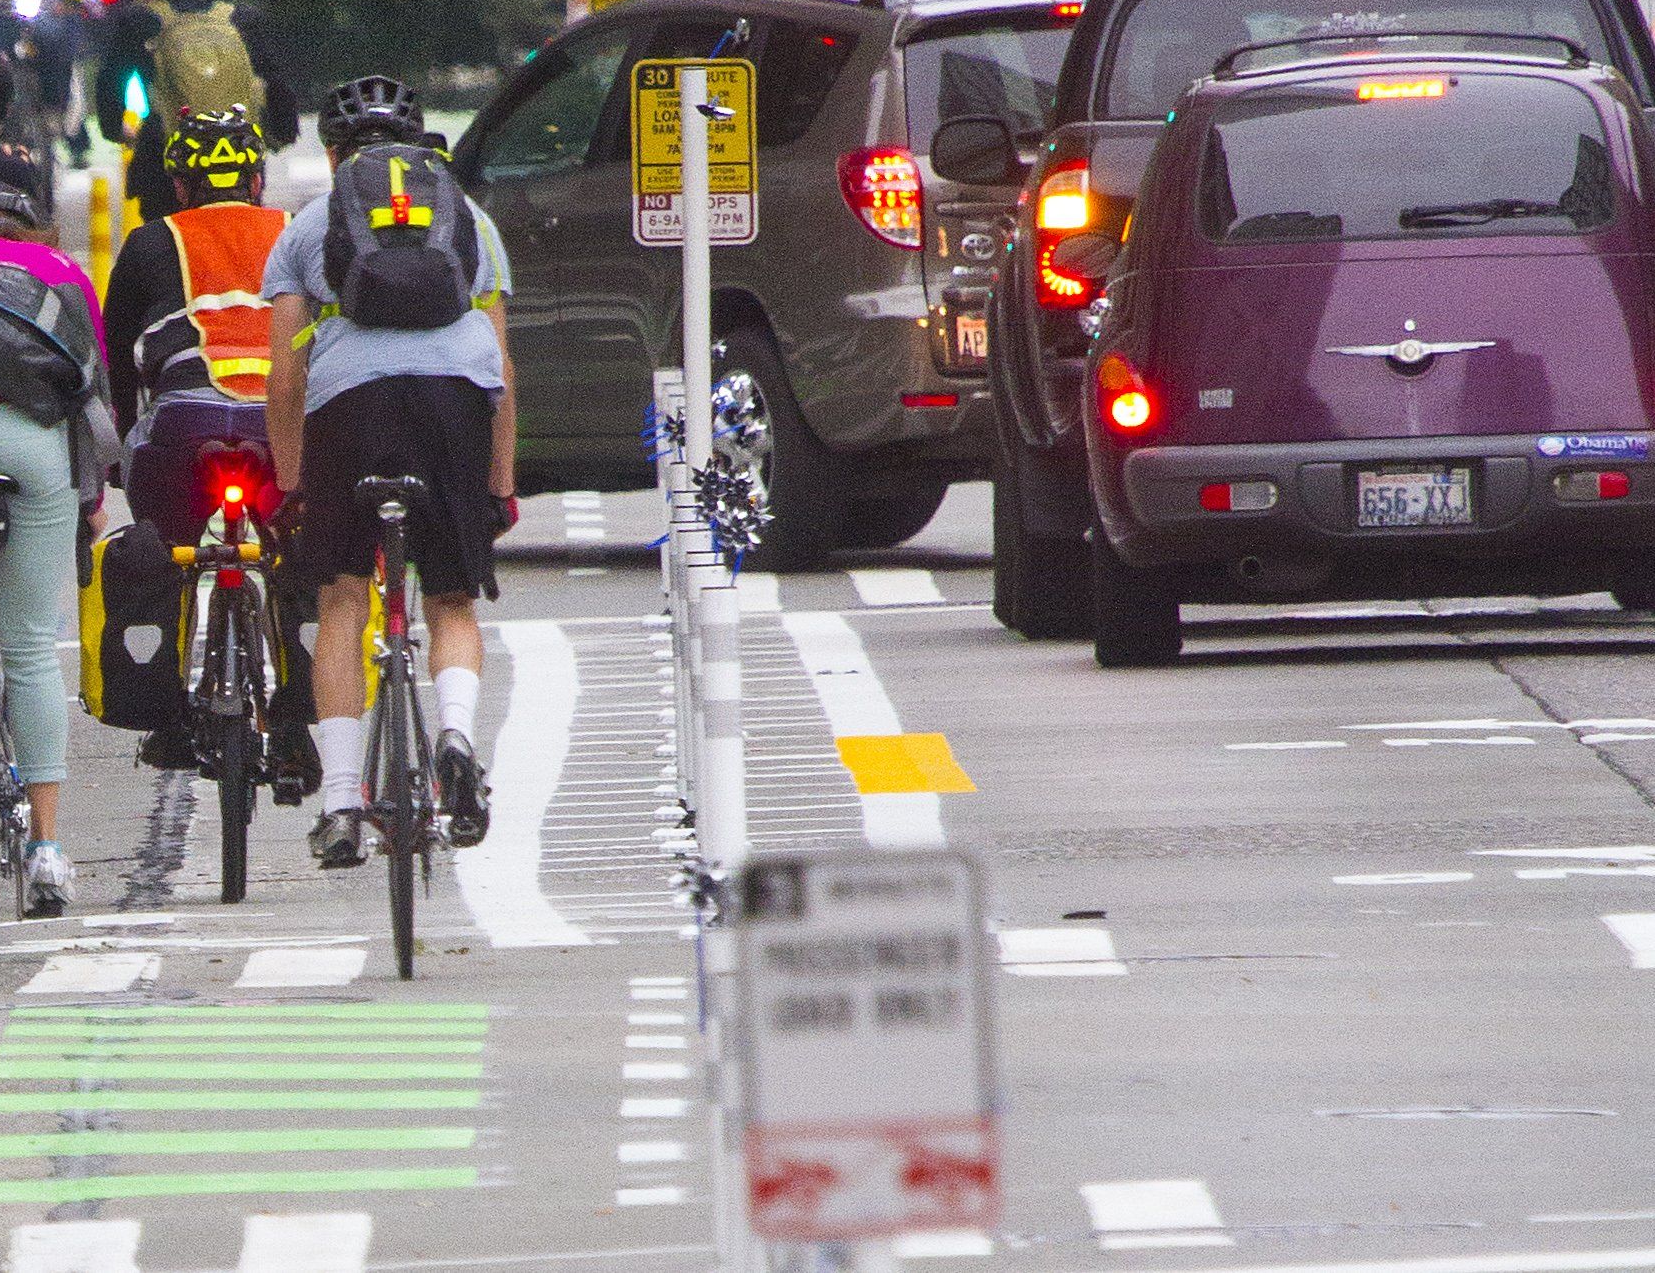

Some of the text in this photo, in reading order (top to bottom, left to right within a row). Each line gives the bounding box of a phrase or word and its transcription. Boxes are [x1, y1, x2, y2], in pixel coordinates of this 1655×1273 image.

[644, 69, 669, 86] 30
[654, 110, 681, 123] LOA
[645, 195, 667, 209] NO
